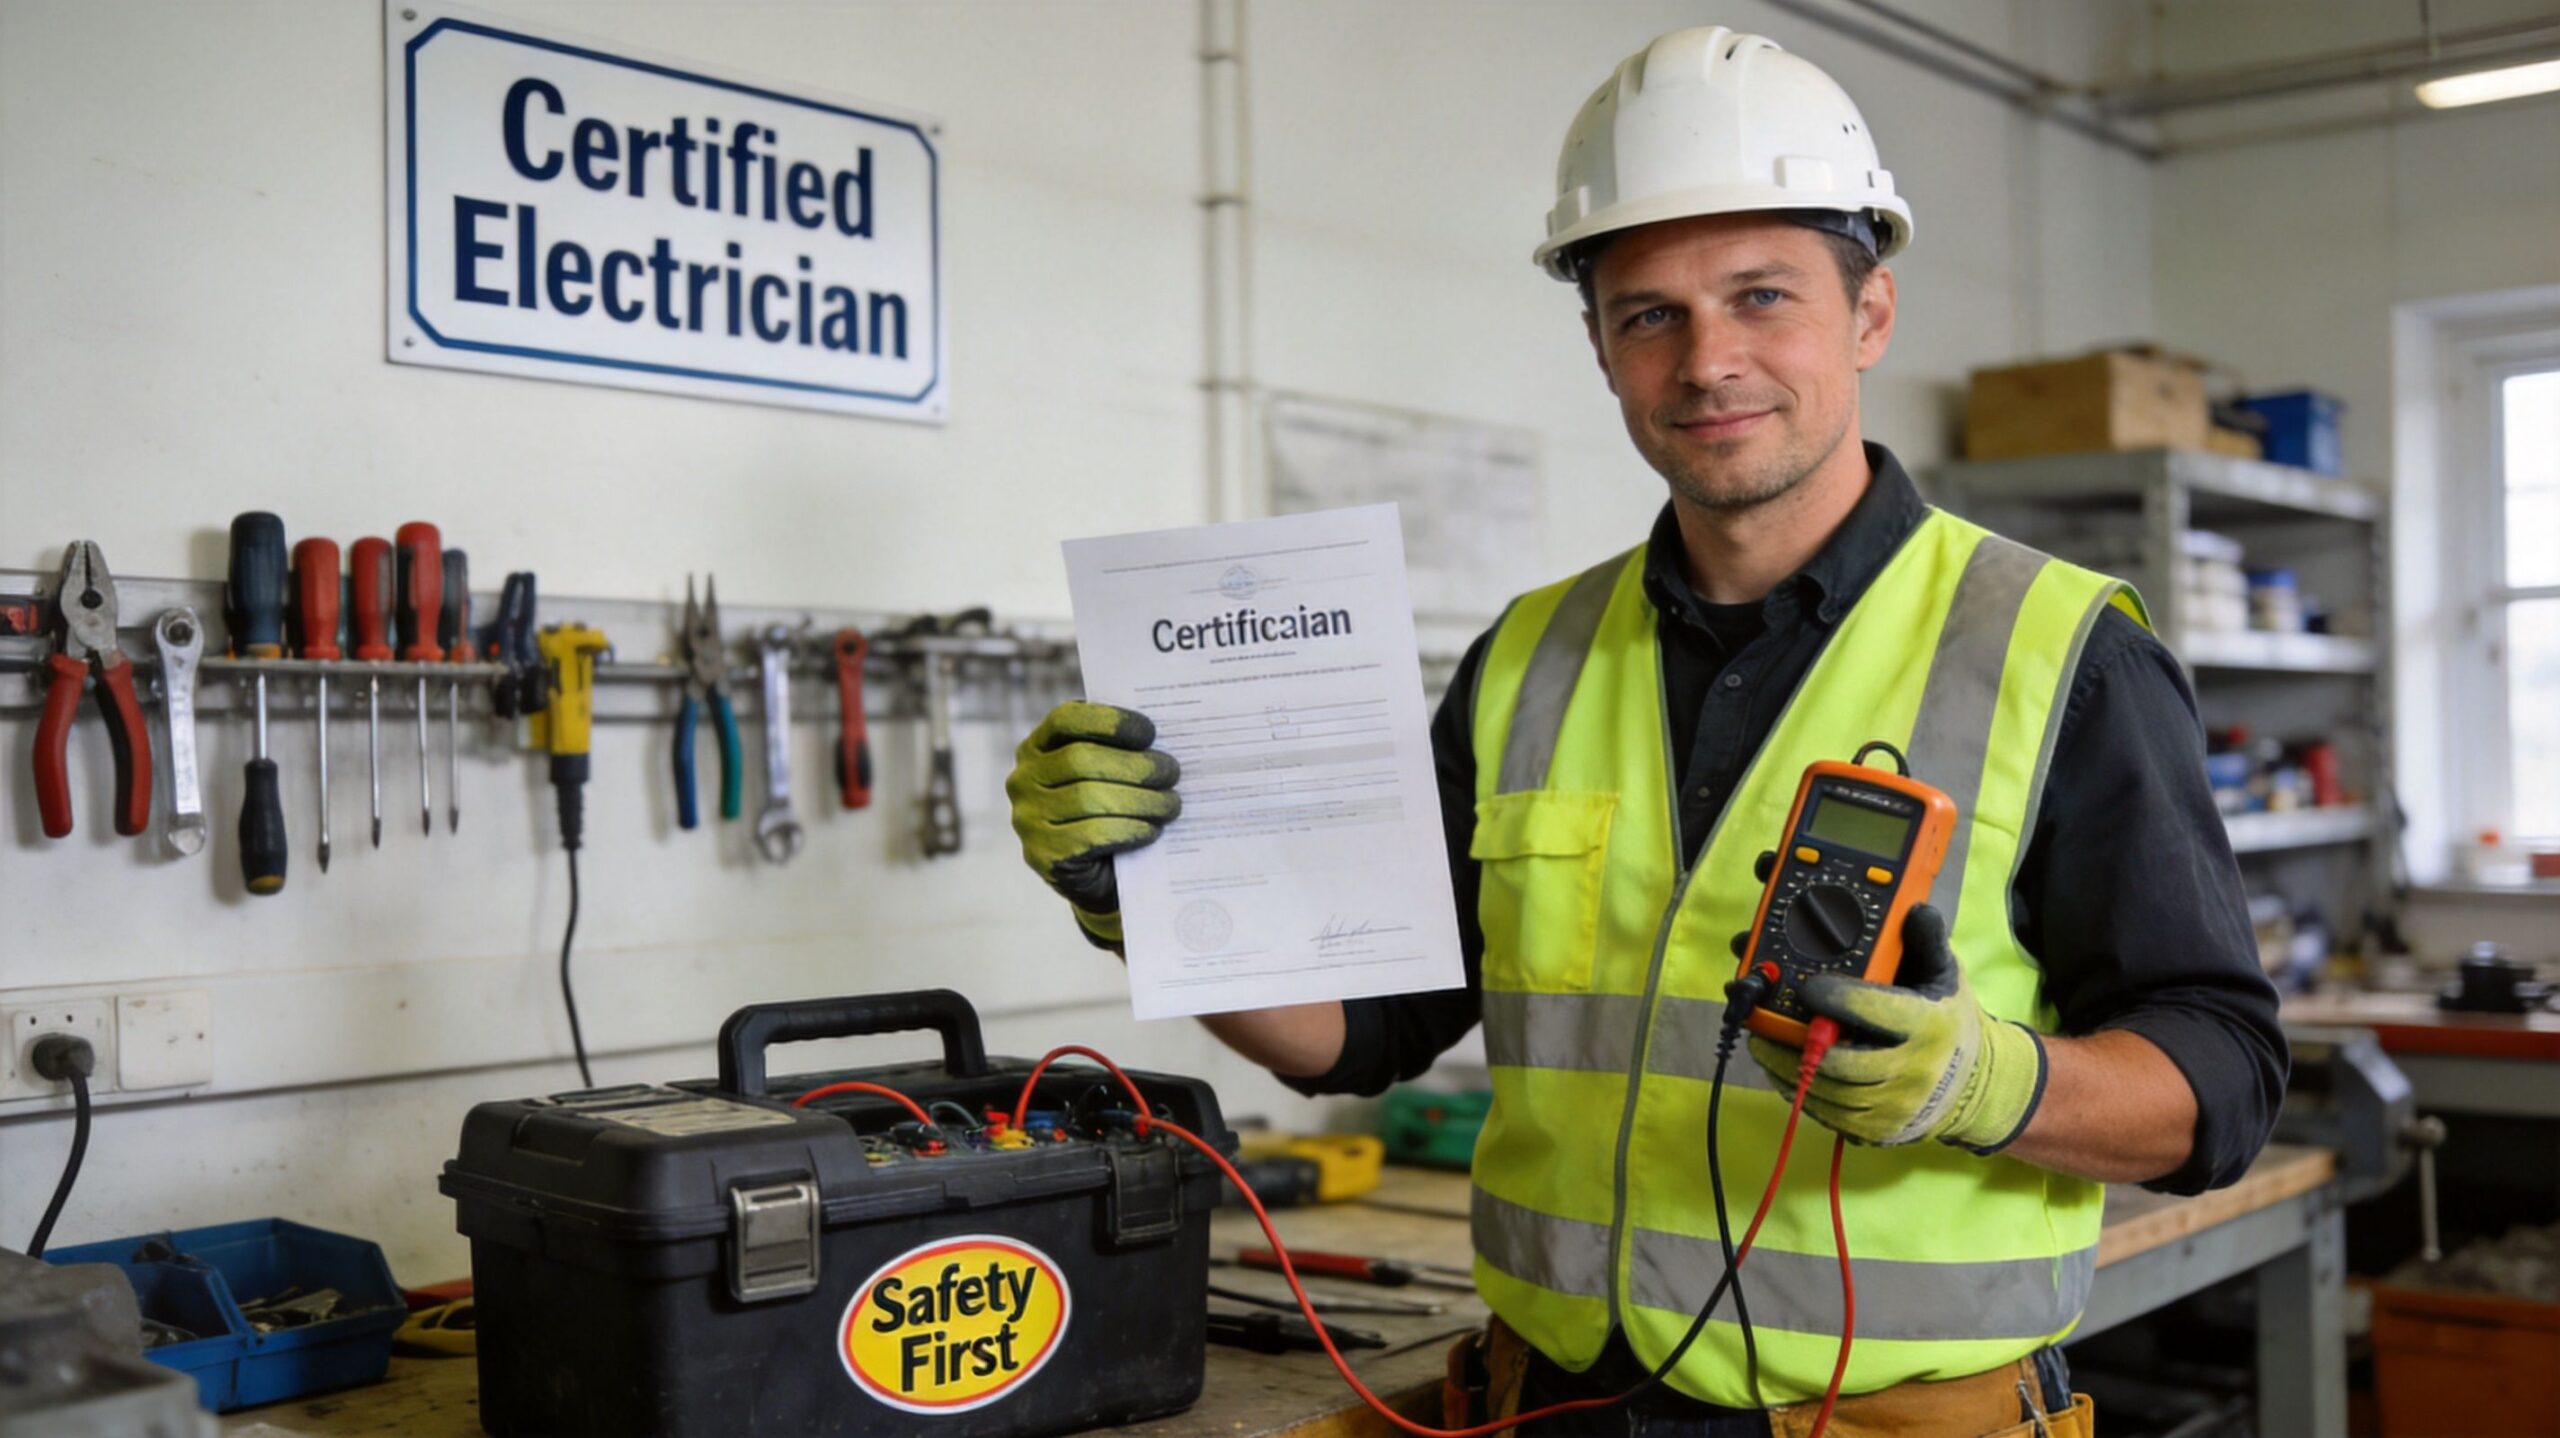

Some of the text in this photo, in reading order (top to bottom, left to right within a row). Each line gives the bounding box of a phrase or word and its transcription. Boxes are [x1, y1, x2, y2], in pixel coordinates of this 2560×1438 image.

[502, 77, 873, 239] Certified
[453, 195, 908, 360] Electrician
[1152, 604, 1352, 653] Certificaian
[871, 1263, 1037, 1333] Safety
[901, 1323, 1019, 1392] First
